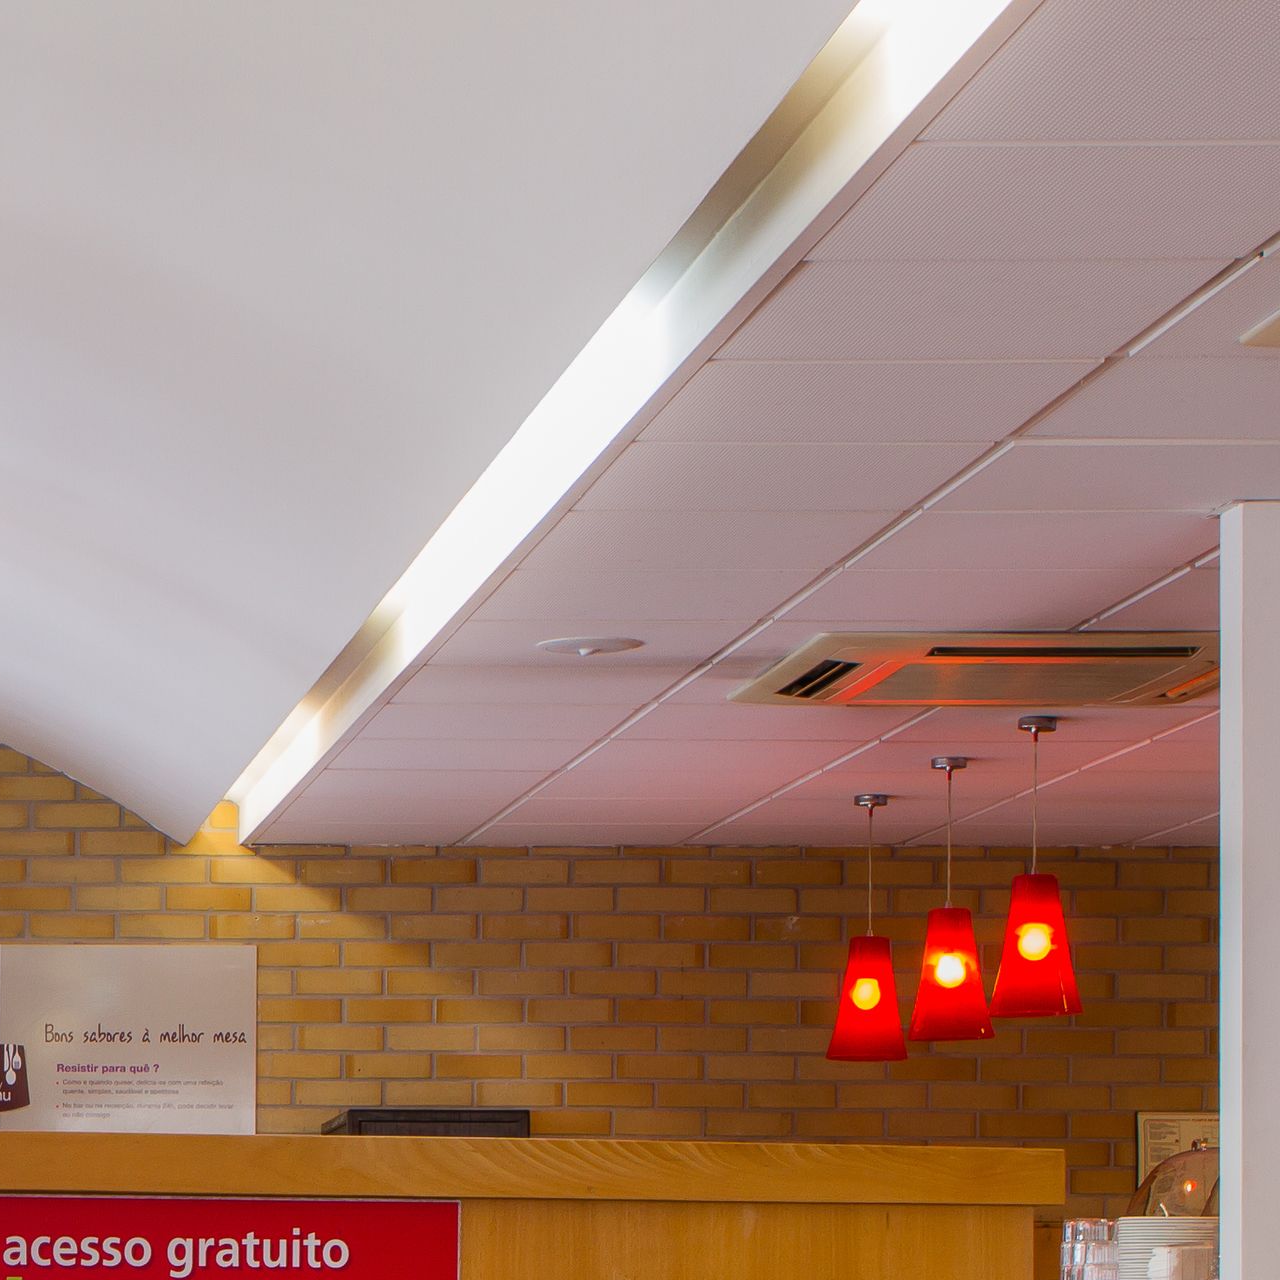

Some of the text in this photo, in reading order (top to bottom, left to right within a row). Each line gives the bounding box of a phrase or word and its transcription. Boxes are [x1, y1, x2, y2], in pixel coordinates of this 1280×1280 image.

[44, 1023, 247, 1043] Bons sabores à melhor mesa
[56, 1063, 99, 1073] Resistir
[101, 1065, 126, 1074] para
[129, 1063, 150, 1075] quê
[3, 1228, 349, 1278] acesso gratuito
